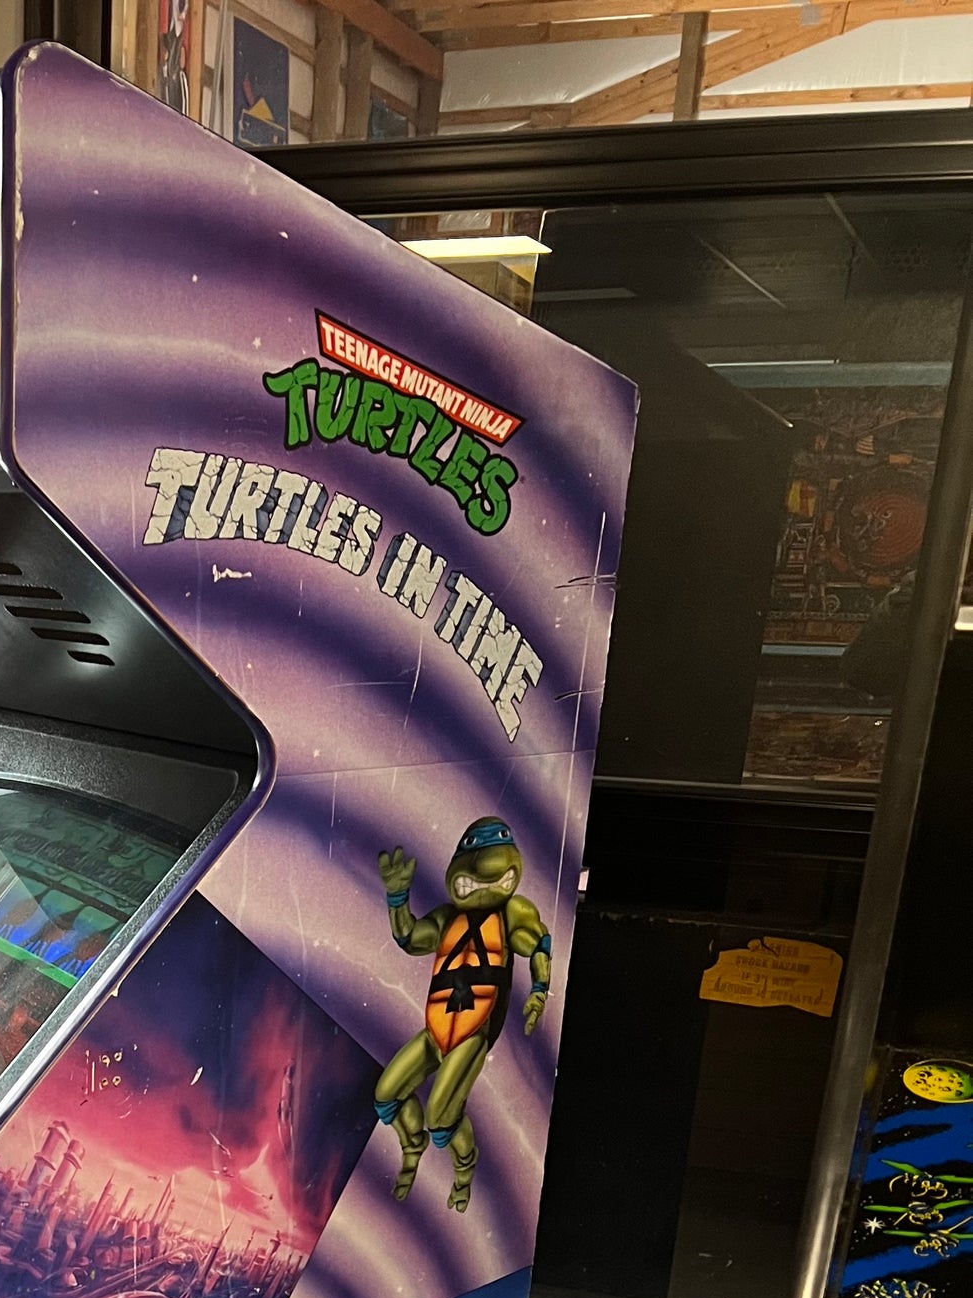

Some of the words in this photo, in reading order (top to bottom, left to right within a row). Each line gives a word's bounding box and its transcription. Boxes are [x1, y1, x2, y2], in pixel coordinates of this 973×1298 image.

[265, 359, 519, 535] TURTLES
[321, 321, 402, 385] TEENAGE
[400, 365, 466, 416] MUTANT
[460, 398, 513, 439] NINJA
[143, 447, 382, 576] TURTLES
[378, 532, 447, 618] IN
[435, 571, 543, 743] TIME
